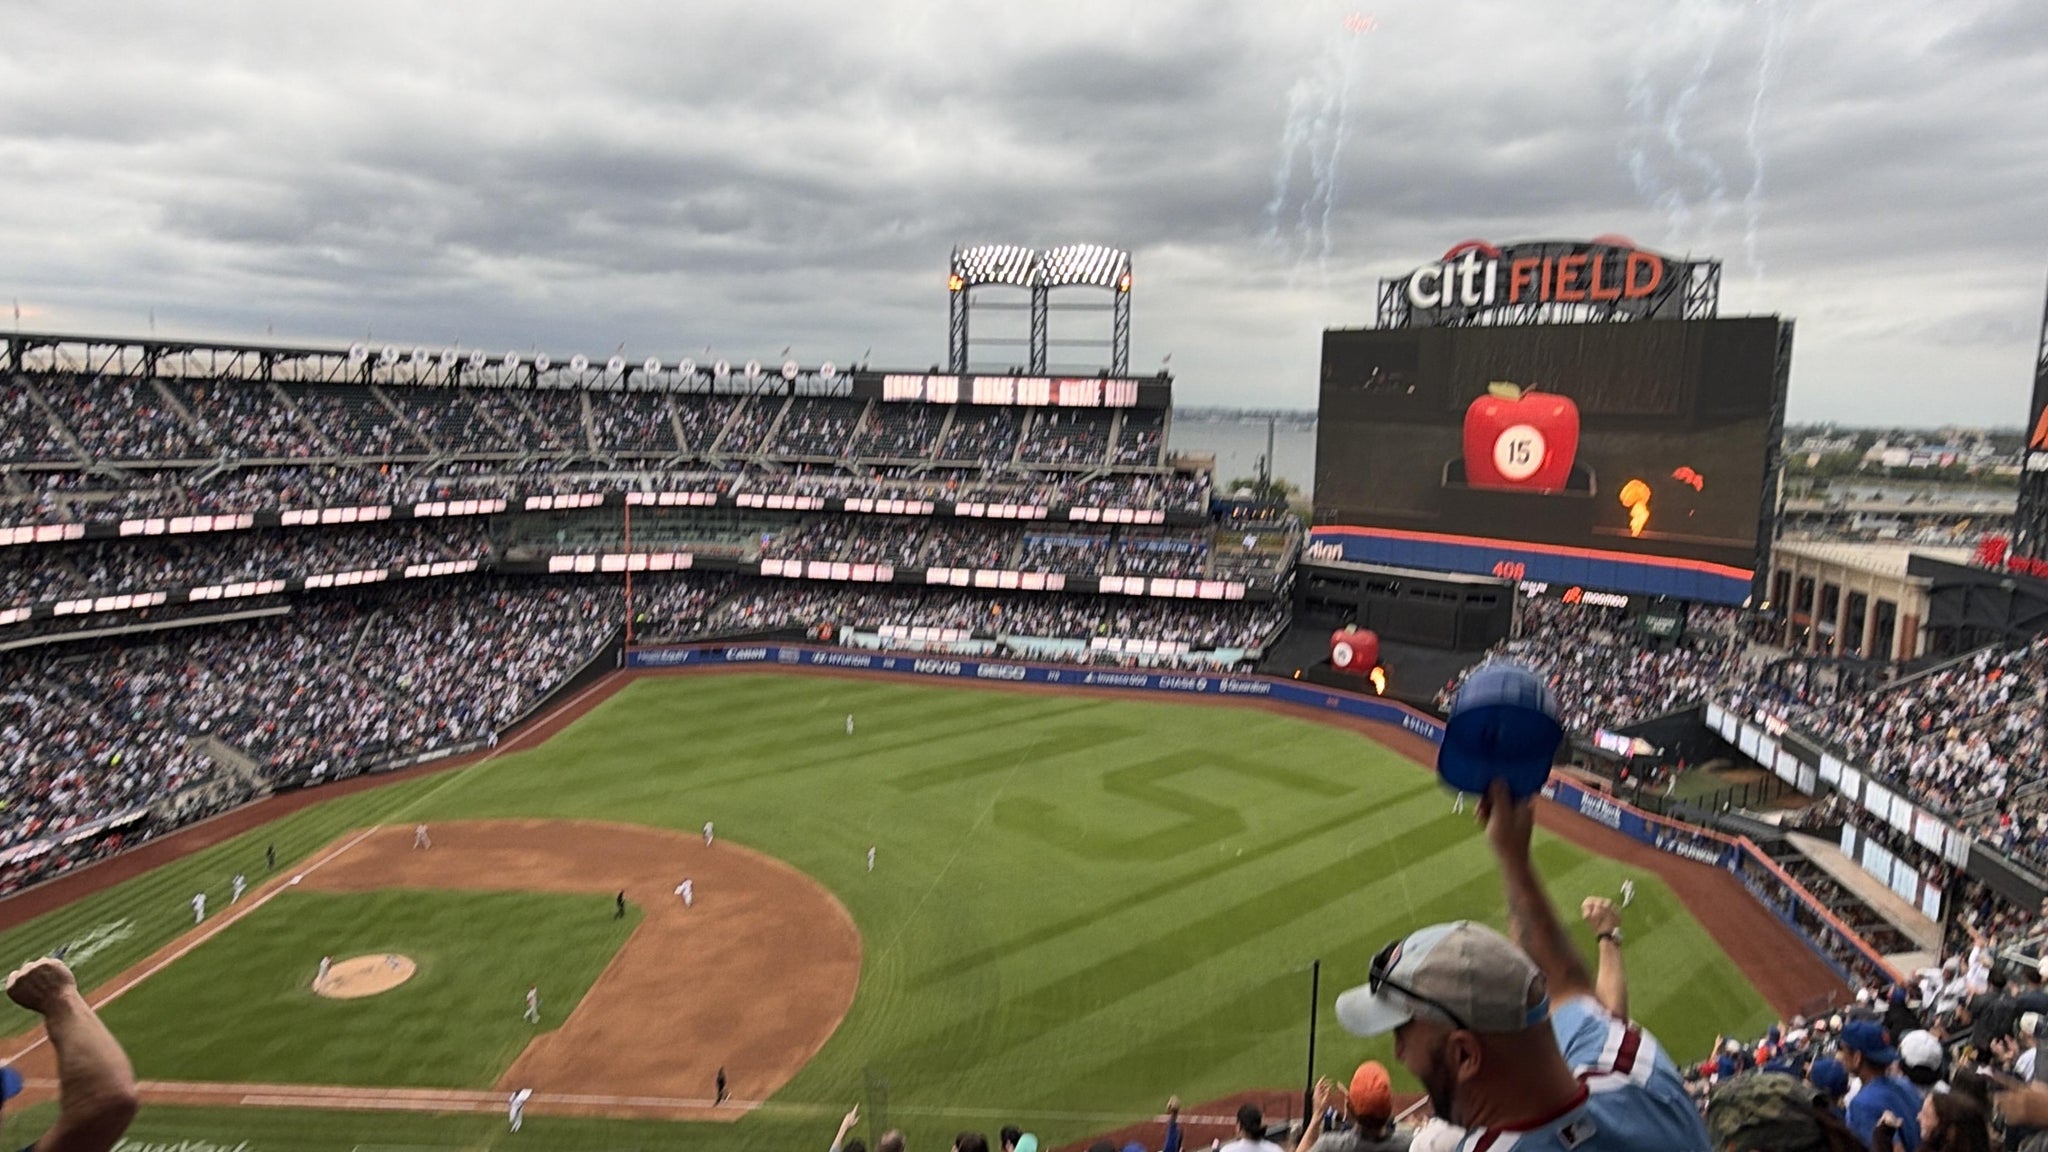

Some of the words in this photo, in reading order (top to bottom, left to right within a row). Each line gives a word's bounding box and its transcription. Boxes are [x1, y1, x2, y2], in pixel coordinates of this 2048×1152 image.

[1408, 249, 1498, 309] citi
[1509, 252, 1663, 304] FIELD
[1507, 438, 1531, 466] 15
[1492, 561, 1525, 581] 408
[725, 647, 766, 661] Canon
[977, 663, 1026, 681] GEICO
[1159, 677, 1196, 690] CHASE
[1228, 680, 1272, 695] Guardian
[1581, 792, 1602, 811] Hard
[1600, 798, 1622, 819] Rock
